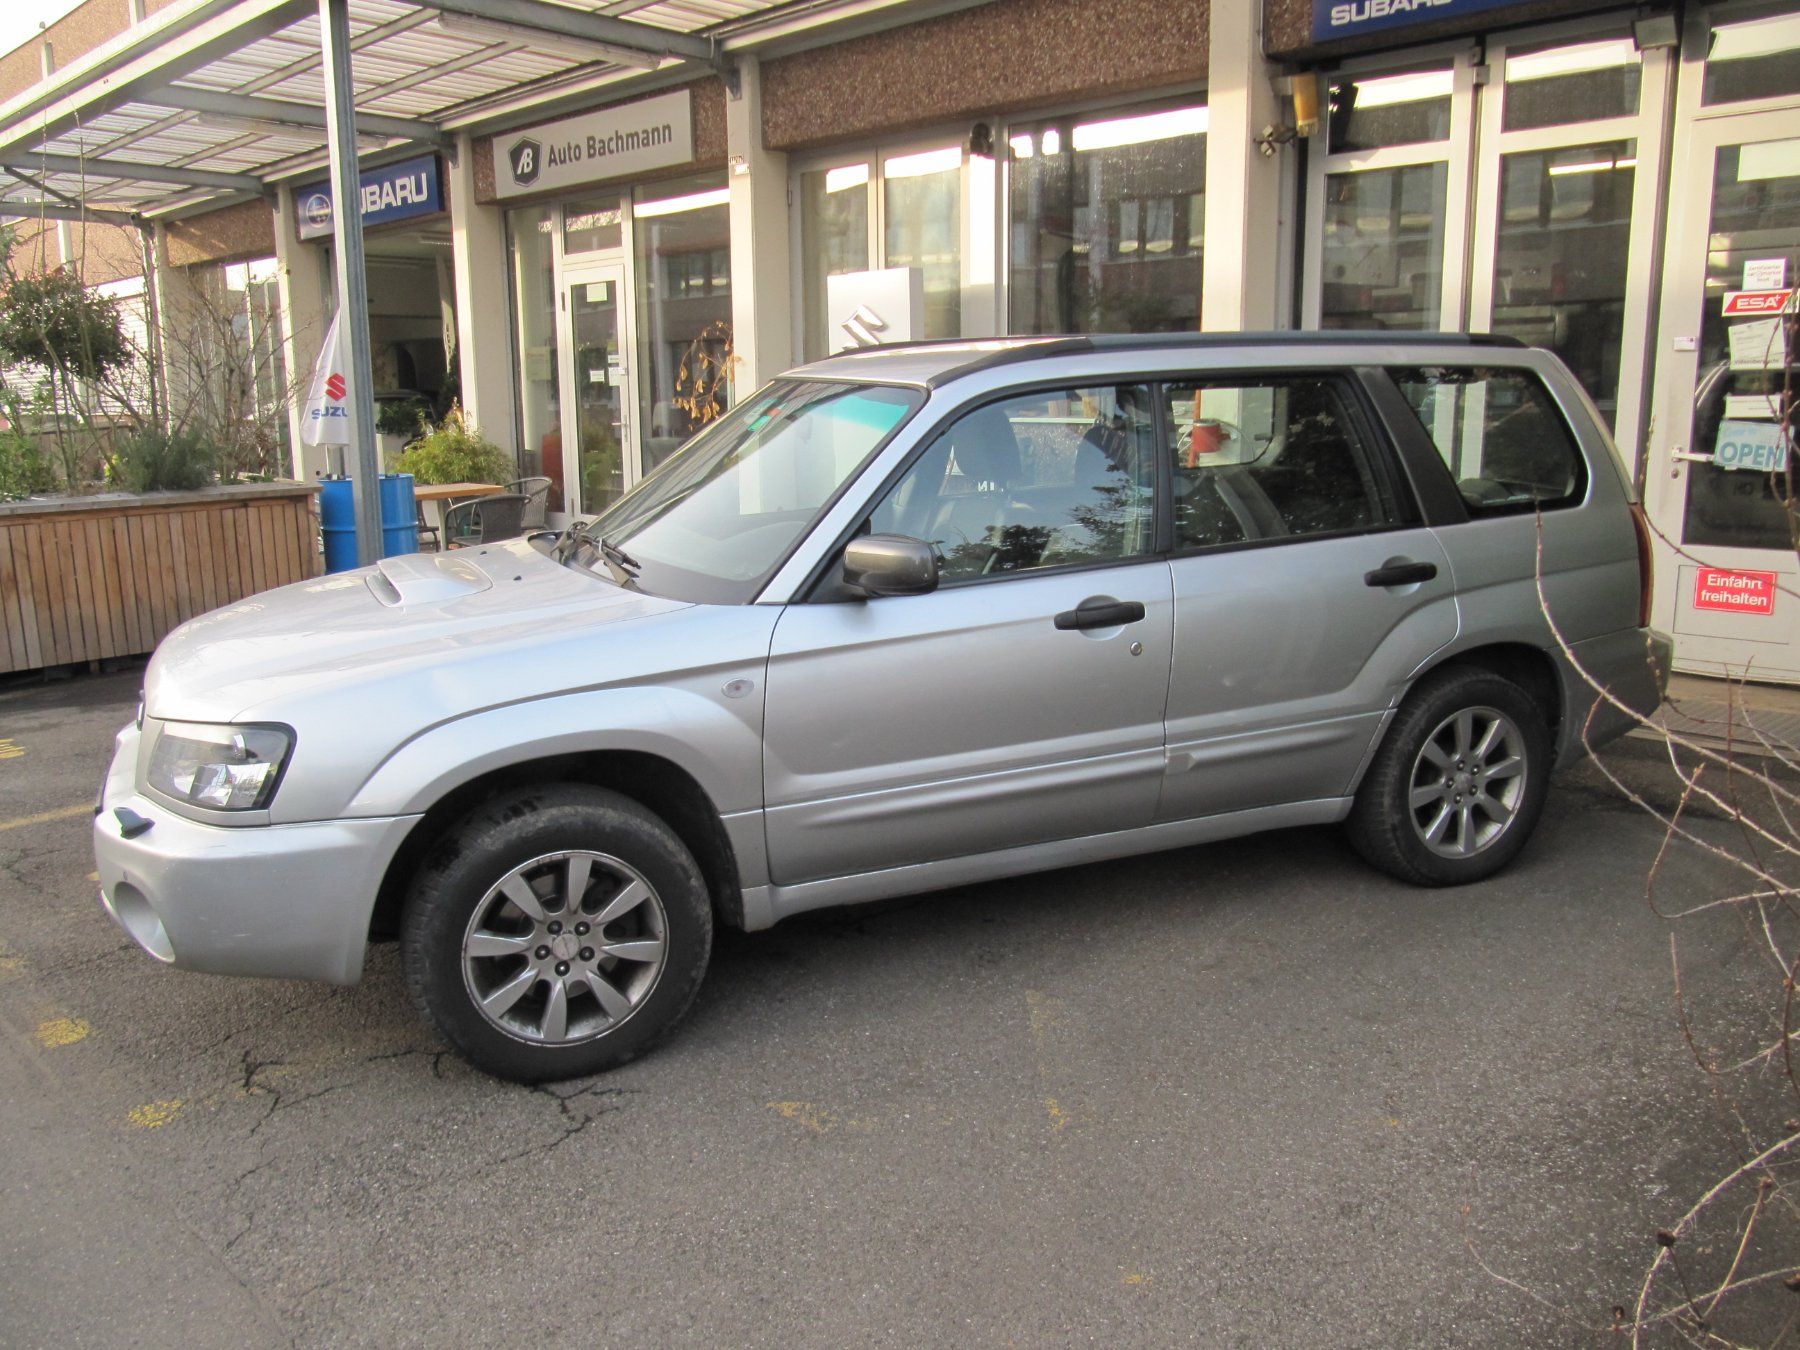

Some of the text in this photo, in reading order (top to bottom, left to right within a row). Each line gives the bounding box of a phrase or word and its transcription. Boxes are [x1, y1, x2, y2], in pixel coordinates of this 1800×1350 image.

[1331, 0, 1452, 26] SUBA
[548, 122, 673, 168] Auto Bachmann
[360, 172, 428, 215] BARU
[1719, 441, 1785, 468] OPEN
[1706, 573, 1763, 590] Einfahrt
[1701, 589, 1768, 607] freihalten
